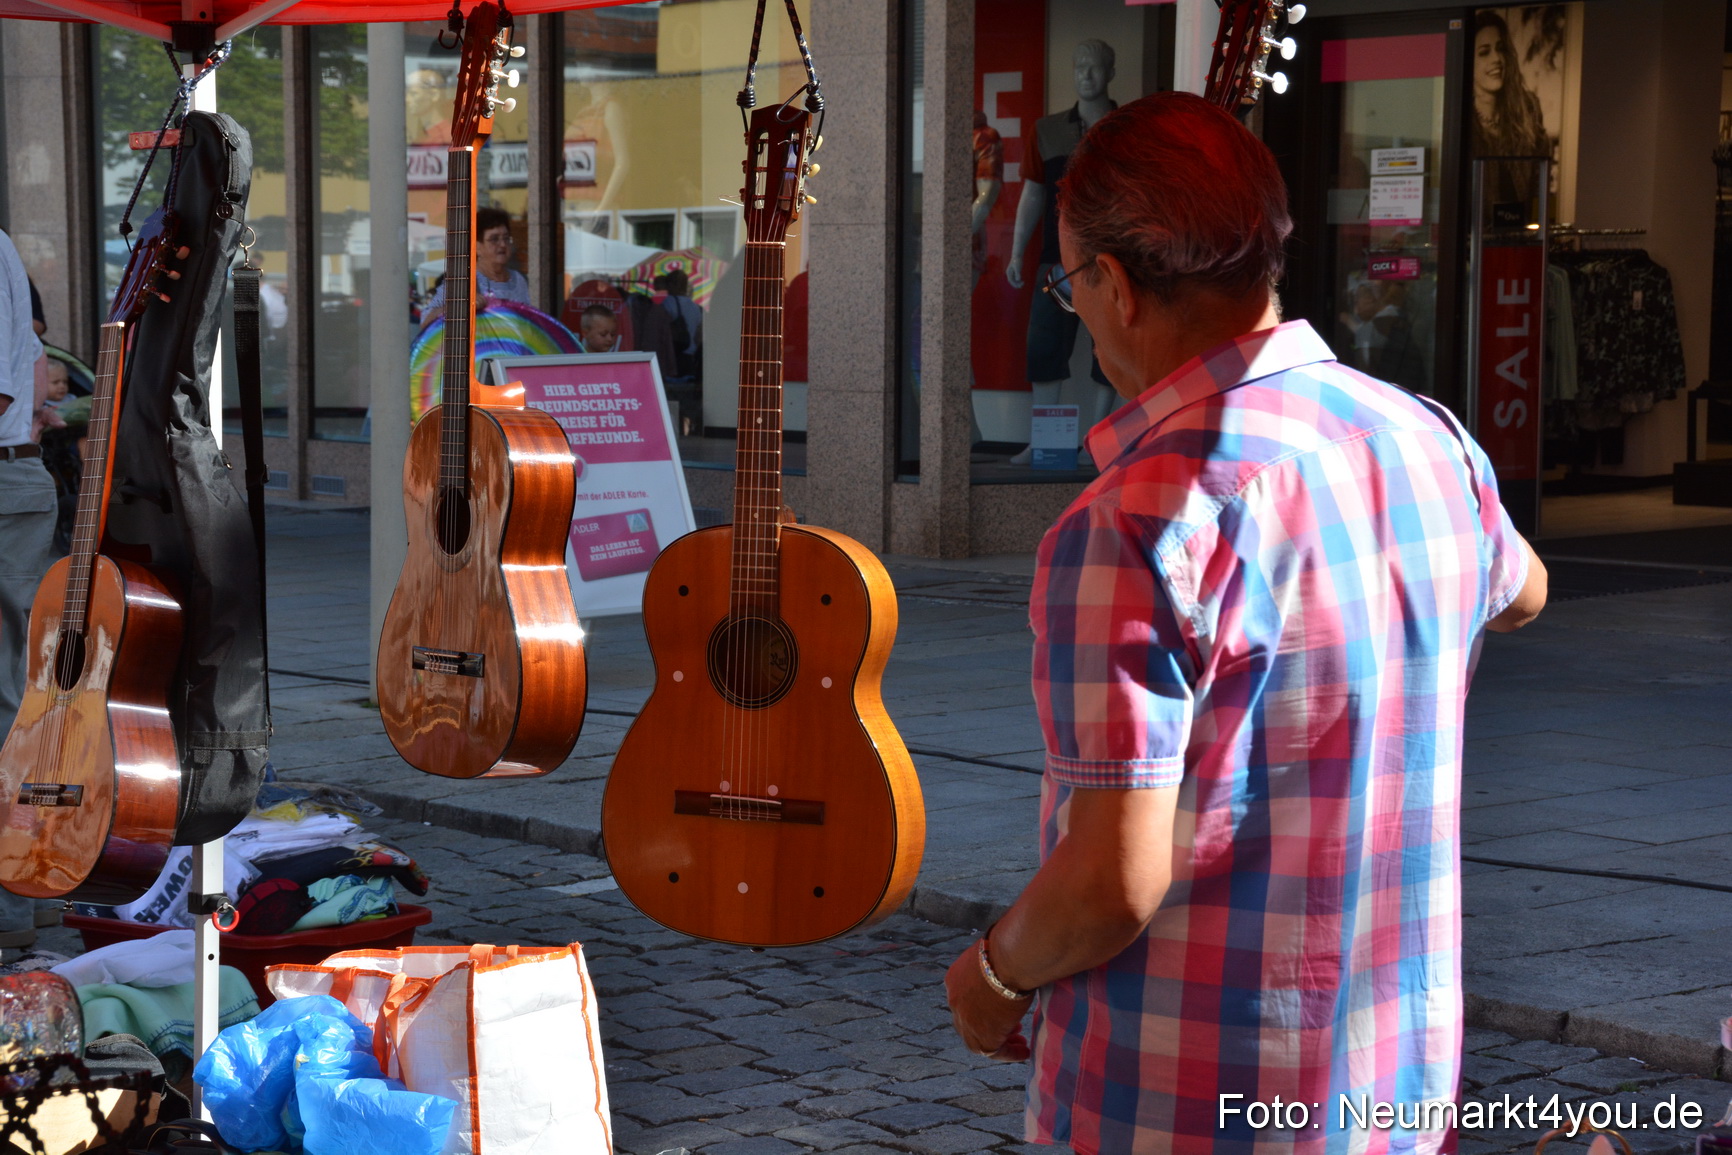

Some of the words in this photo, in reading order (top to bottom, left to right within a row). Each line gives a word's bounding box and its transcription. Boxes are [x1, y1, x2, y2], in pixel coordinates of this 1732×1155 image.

[1493, 278, 1530, 429] SALE
[543, 384, 577, 396] HIER
[578, 383, 621, 395] GIBT'S
[527, 398, 642, 413] FREUNDSCHAFTS-
[599, 412, 626, 427] FÜR
[603, 490, 625, 500] ADLER
[627, 490, 649, 498] Karte.
[573, 523, 600, 535] ADLER
[605, 541, 628, 550] LEBEN
[590, 553, 608, 562] KEIN
[608, 546, 645, 558] LAUFSTEG.
